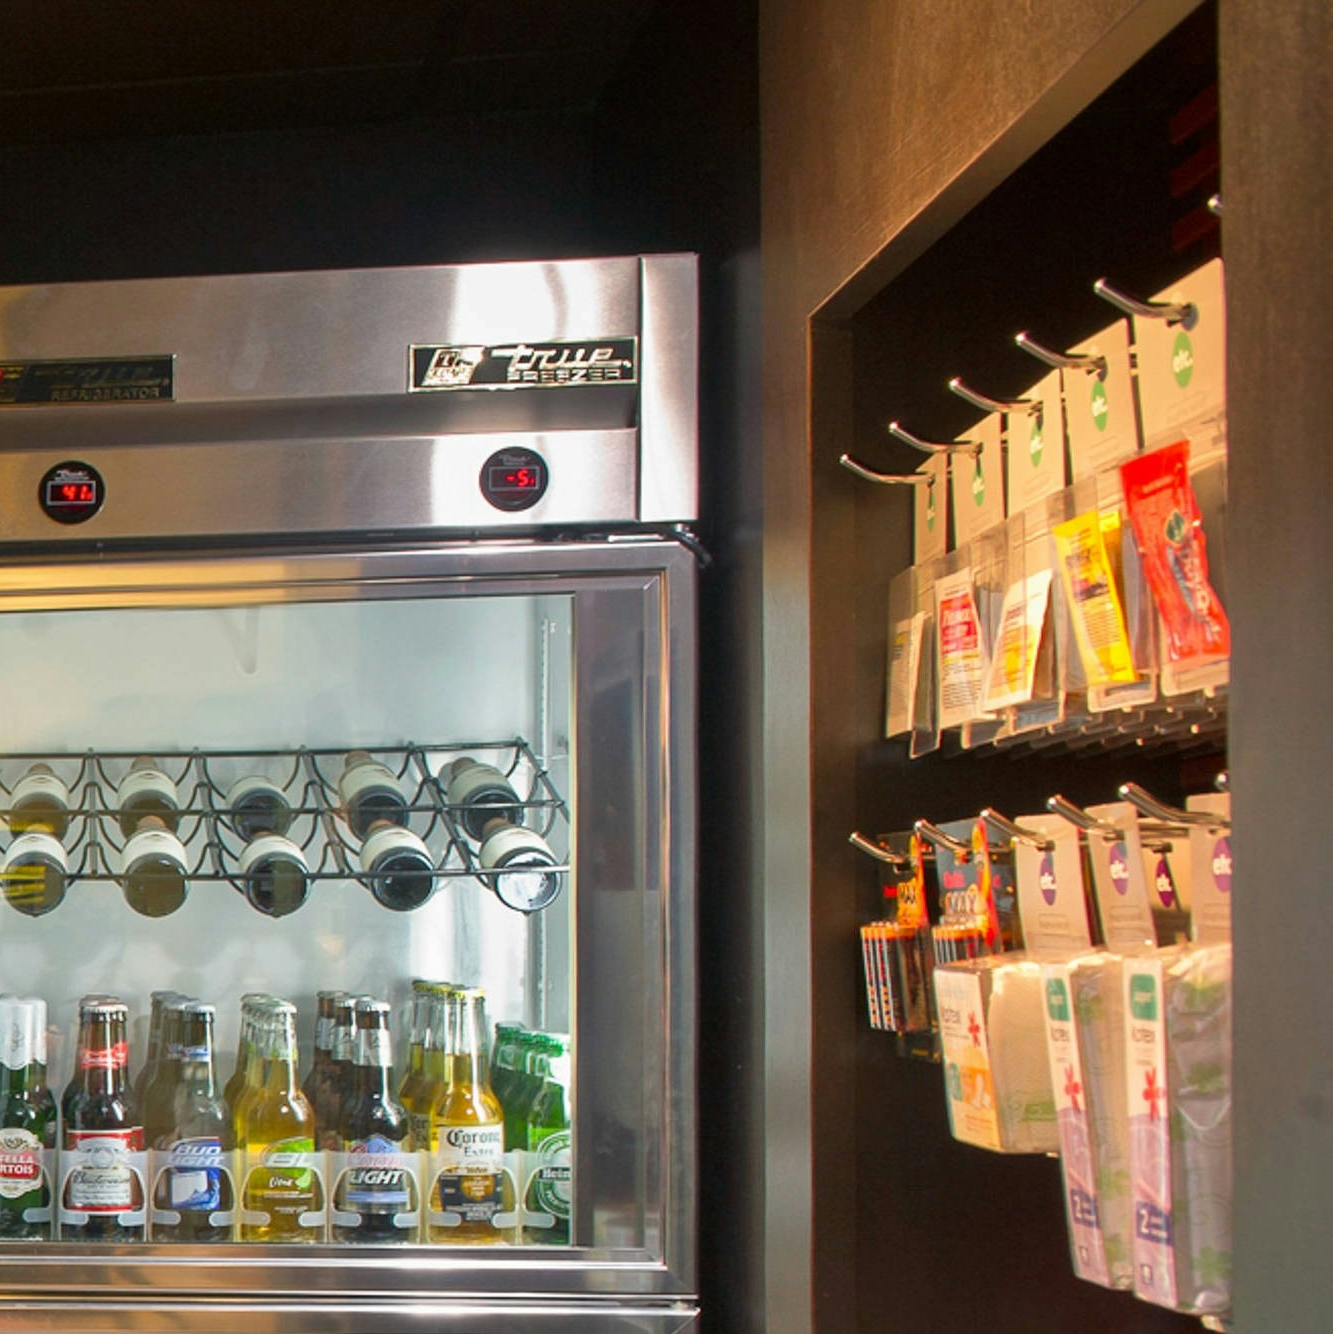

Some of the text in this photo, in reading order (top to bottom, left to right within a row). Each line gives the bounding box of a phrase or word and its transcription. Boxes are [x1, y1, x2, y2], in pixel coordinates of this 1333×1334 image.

[175, 1145, 221, 1156] BUD
[168, 1155, 224, 1167] LIGHT
[541, 1168, 571, 1179] Hein
